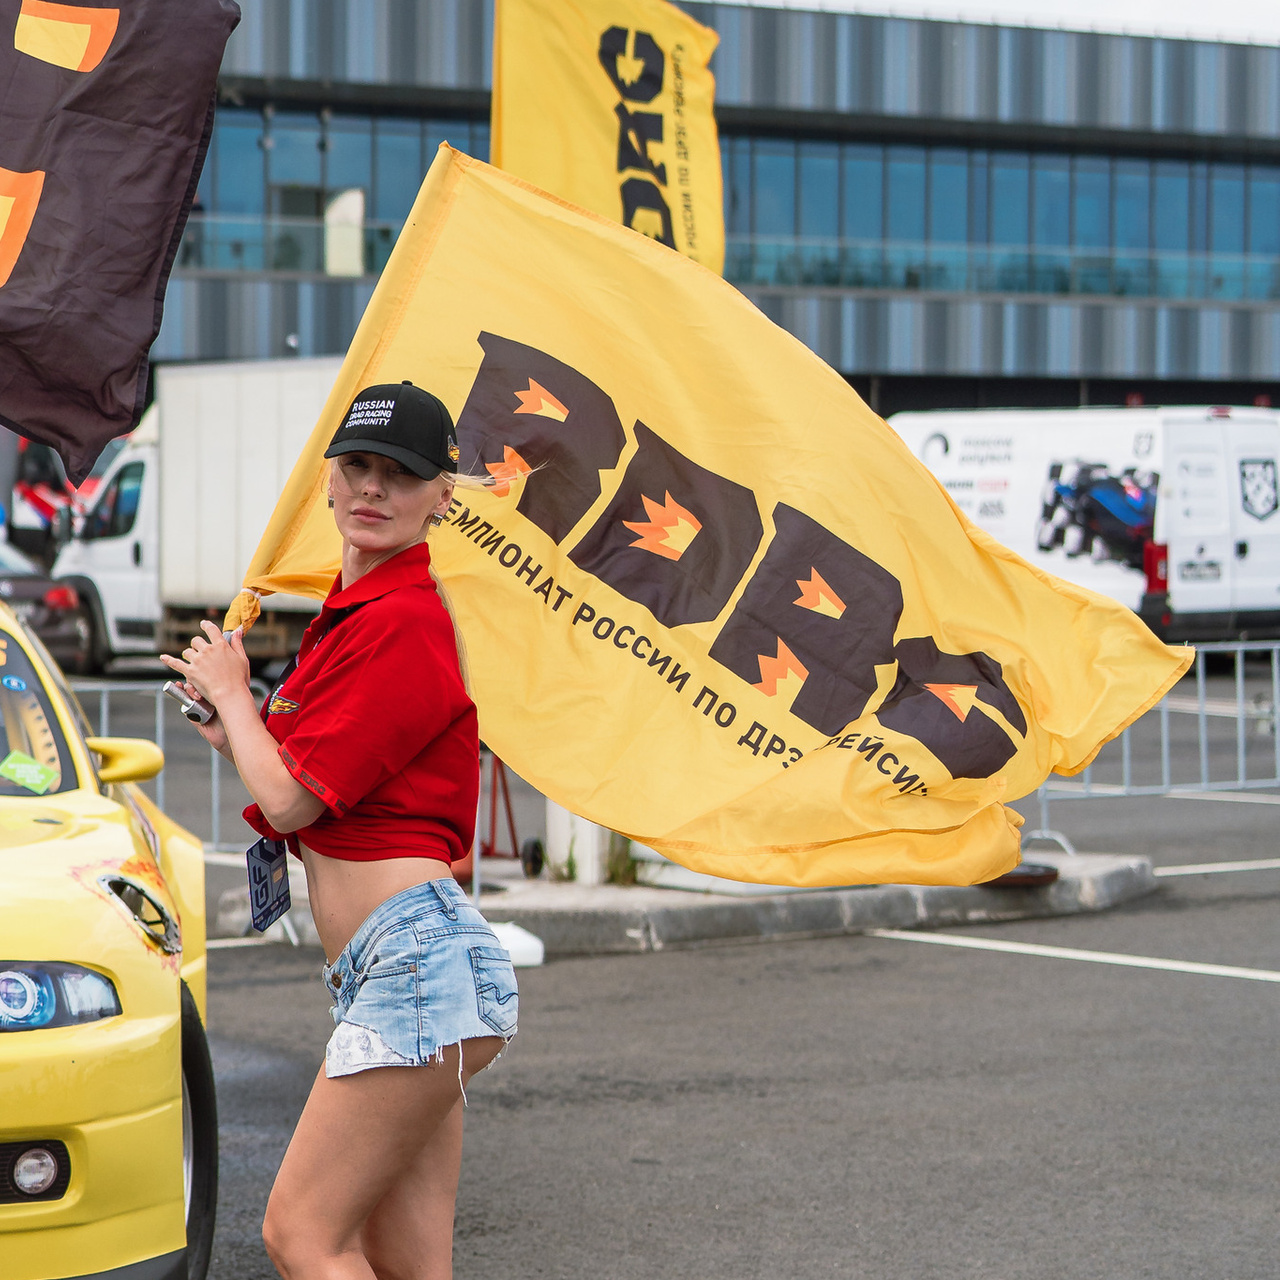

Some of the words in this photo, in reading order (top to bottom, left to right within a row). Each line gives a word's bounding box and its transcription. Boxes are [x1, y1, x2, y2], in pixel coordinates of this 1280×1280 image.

[599, 25, 677, 251] DRC
[352, 400, 395, 412] RUSSIAN
[345, 418, 390, 428] COMMUNITY
[349, 411, 365, 421] DRAG
[364, 410, 392, 418] RACING
[443, 498, 573, 612] ЕМПИОНАТ
[572, 602, 691, 693] РОССИИ
[692, 685, 737, 728] ПО
[737, 721, 804, 768] ДРЭ
[300, 770, 326, 795] RDRC
